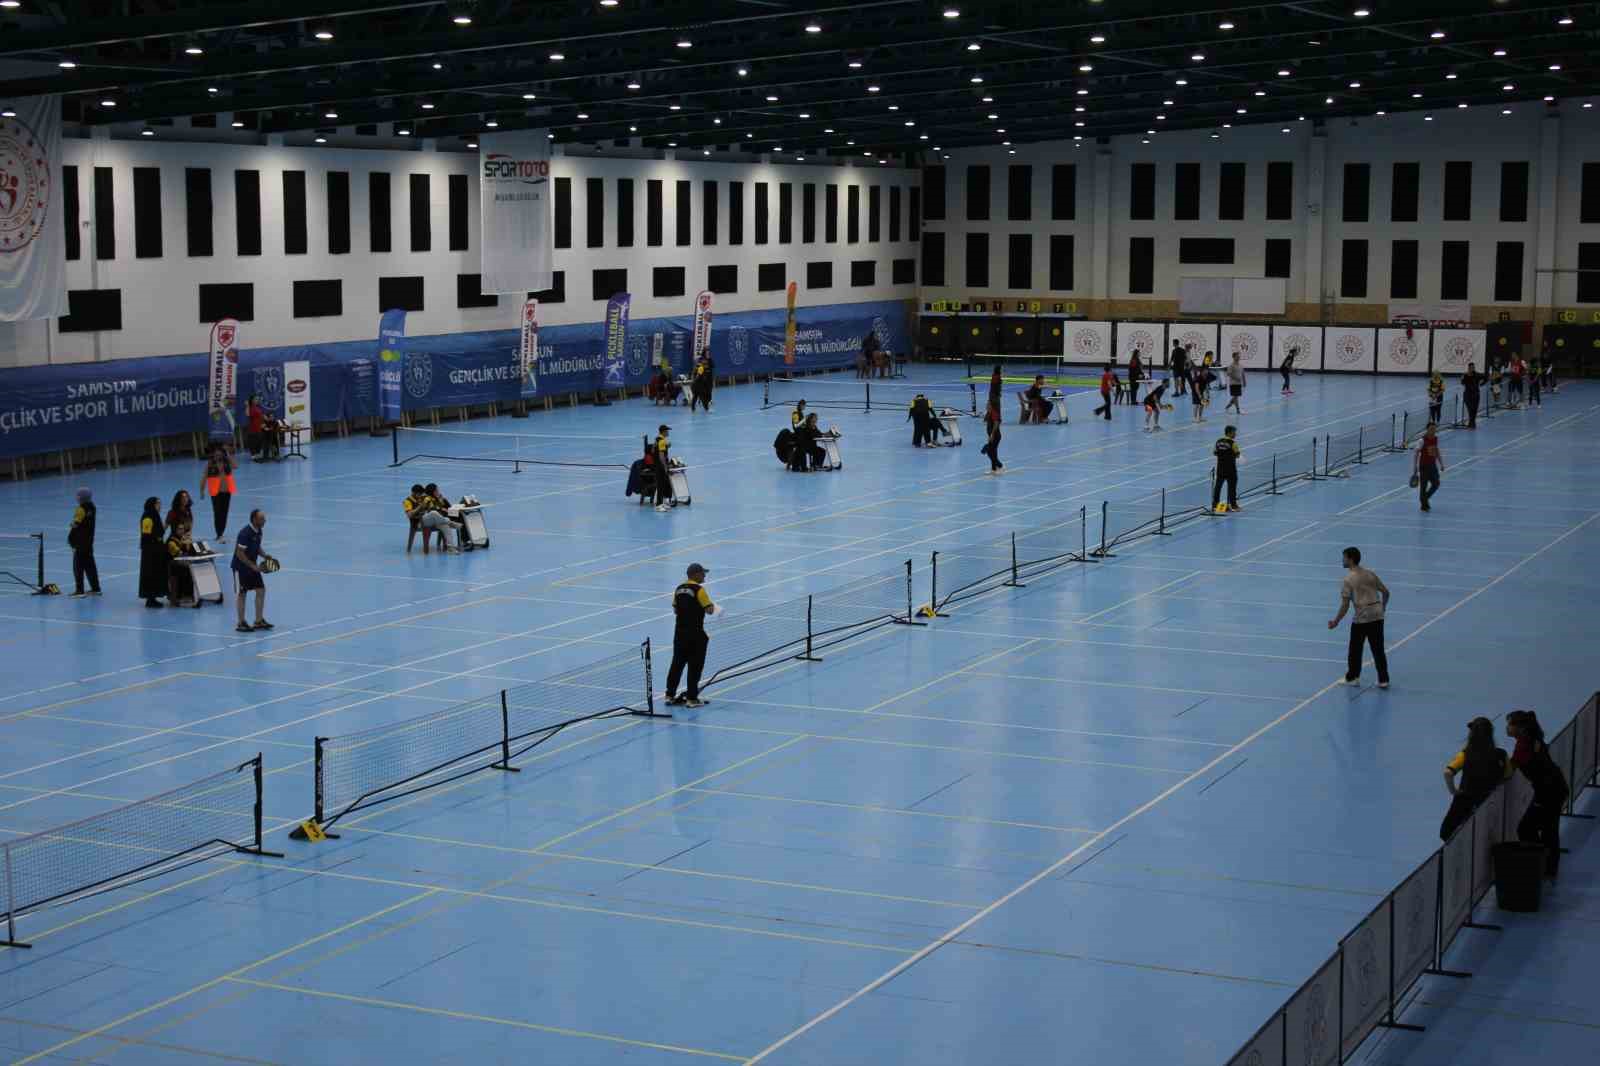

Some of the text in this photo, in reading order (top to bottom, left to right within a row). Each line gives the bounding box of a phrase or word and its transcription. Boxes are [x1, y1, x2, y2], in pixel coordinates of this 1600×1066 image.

[449, 365, 495, 388] GENÇLİK
[495, 366, 509, 380] VE
[67, 380, 136, 399] SAMSUN
[40, 407, 62, 424] VE
[65, 400, 107, 421] SPOR
[114, 393, 127, 415] İL
[131, 383, 208, 412] MÜDÜRLÜ
